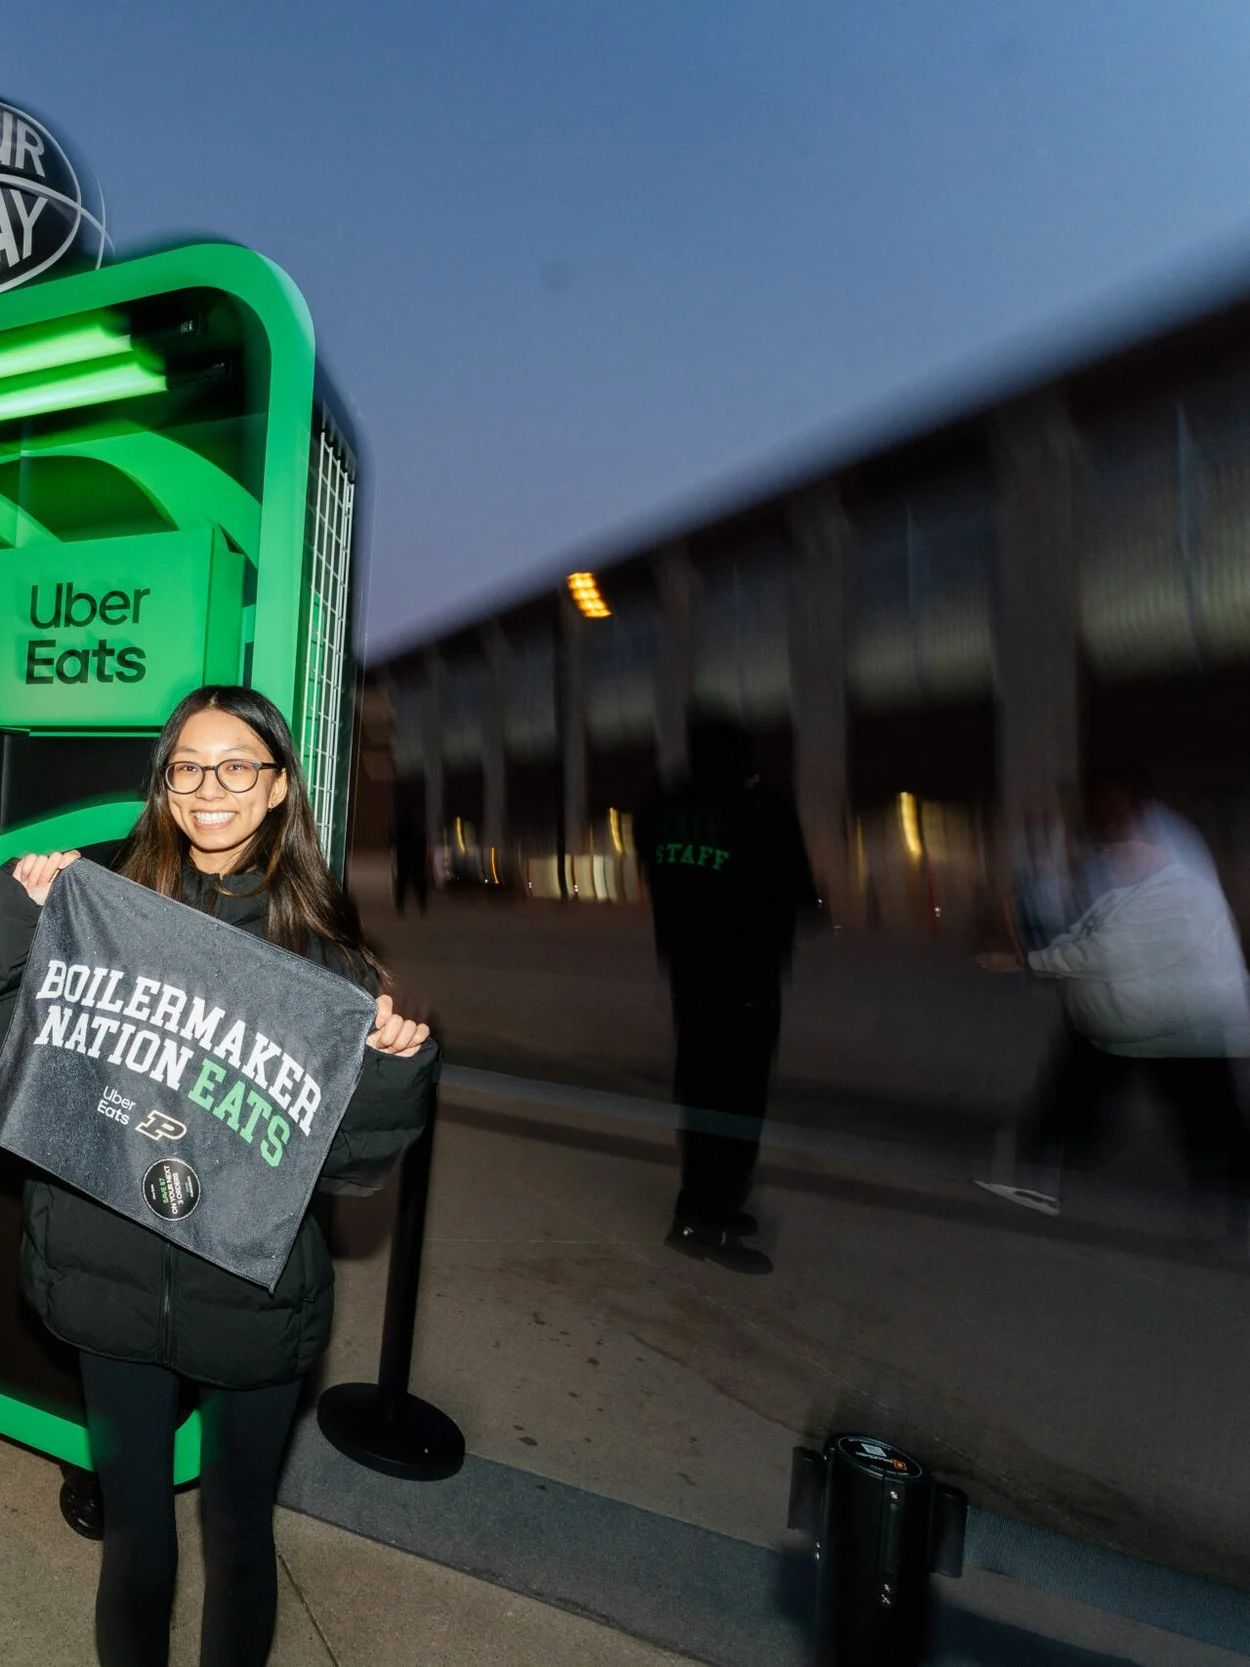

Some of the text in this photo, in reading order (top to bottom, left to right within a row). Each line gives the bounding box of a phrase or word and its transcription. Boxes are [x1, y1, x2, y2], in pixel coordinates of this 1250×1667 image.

[29, 582, 150, 630] Uber
[25, 640, 147, 685] Eats
[656, 843, 730, 870] STAFF
[36, 960, 321, 1137] BOILERMAKER
[34, 1005, 291, 1167] NATION EATS
[103, 1086, 136, 1111] Uber
[97, 1099, 130, 1125] Eats
[134, 1109, 187, 1140] P
[161, 1186, 169, 1204] SAVE
[163, 1165, 178, 1214] ON YOUR NEXT
